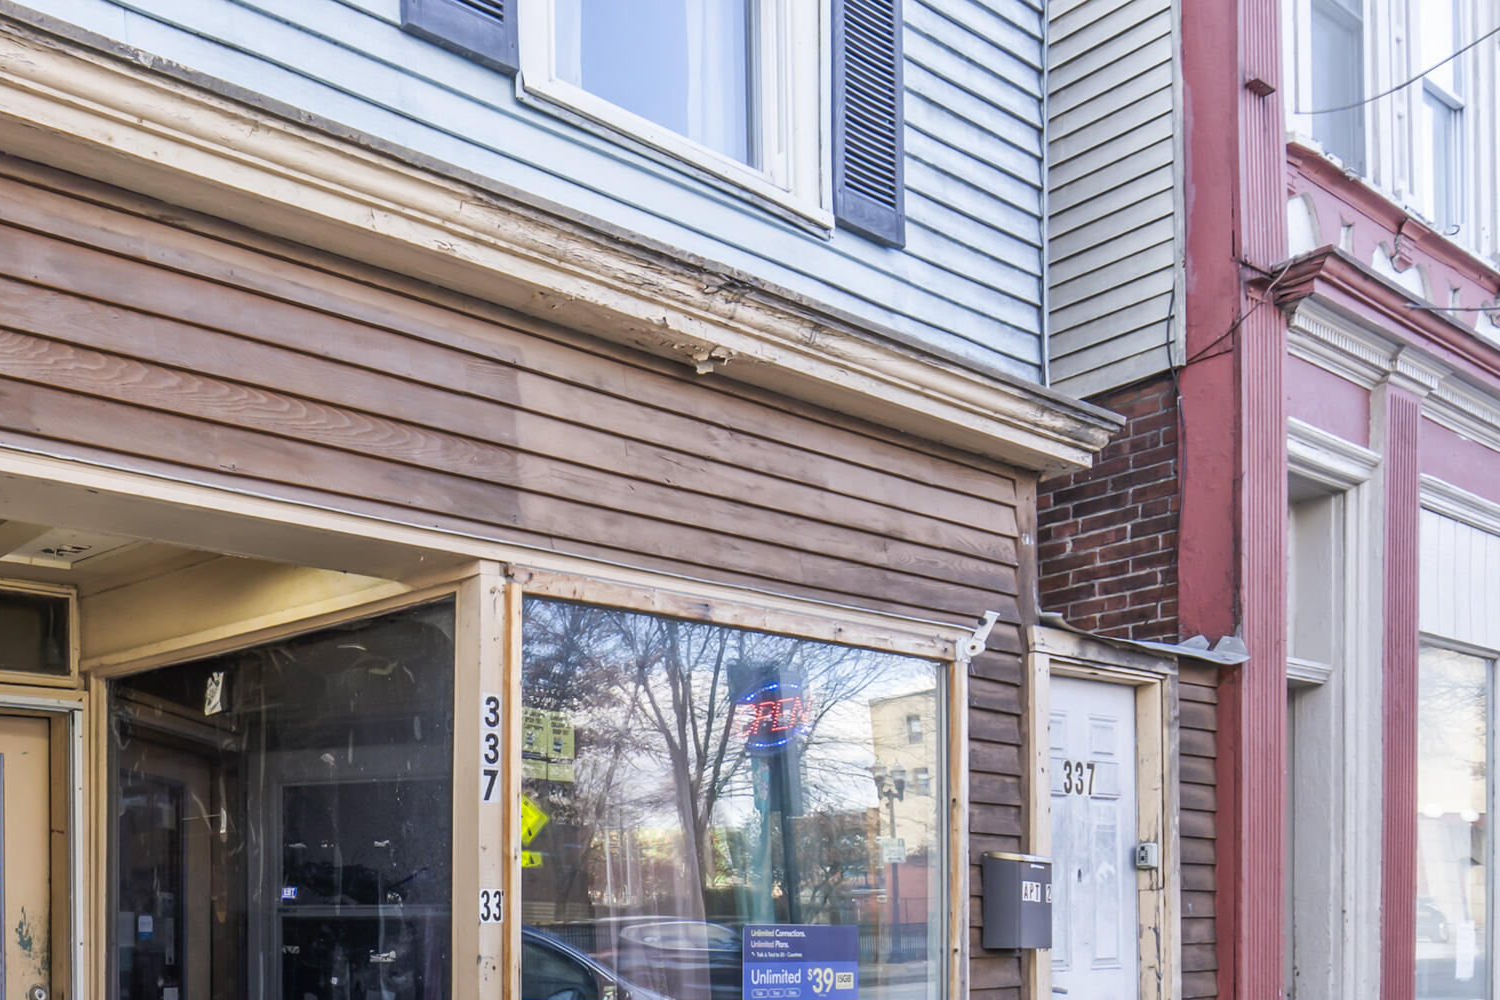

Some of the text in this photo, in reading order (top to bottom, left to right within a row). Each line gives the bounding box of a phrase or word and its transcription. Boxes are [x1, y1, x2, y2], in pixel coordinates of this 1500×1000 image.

[734, 694, 813, 737] OPEN
[1063, 760, 1095, 795] 337
[750, 967, 834, 993] Unlimited $39
